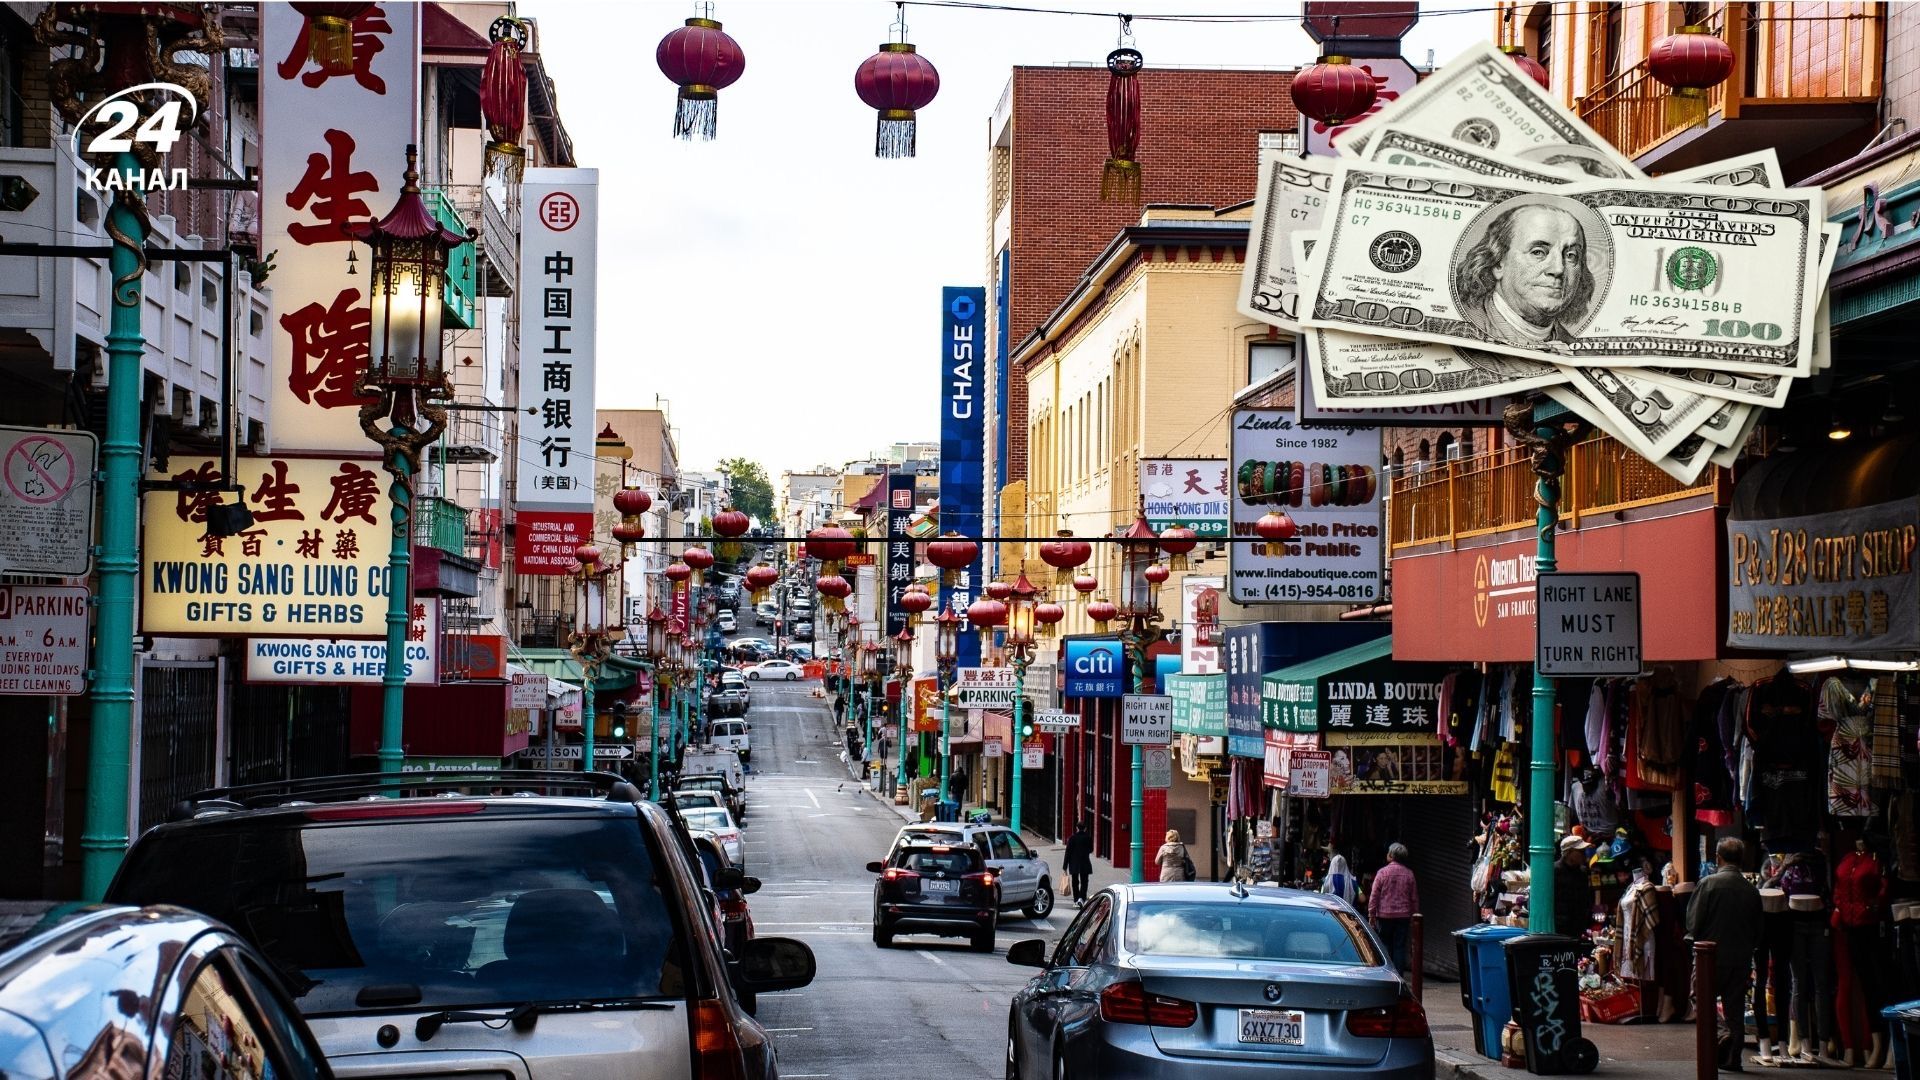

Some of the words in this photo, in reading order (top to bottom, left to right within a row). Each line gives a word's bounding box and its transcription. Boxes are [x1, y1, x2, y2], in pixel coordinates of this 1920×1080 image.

[541, 250, 574, 469] 中国工商银行
[952, 324, 973, 420] CHASE
[1237, 414, 1293, 431] Linda
[1275, 438, 1308, 449] Since
[1311, 438, 1338, 449] 1982
[1146, 463, 1174, 476] 香港
[1147, 502, 1173, 515] HONG
[1175, 502, 1201, 515] KONG
[1203, 502, 1220, 515] DIM
[563, 522, 575, 532] AND
[1332, 521, 1379, 538] Price
[532, 544, 540, 553] OF
[1305, 542, 1362, 557] Public
[1782, 528, 1807, 586] 28
[1811, 535, 1857, 584] GIFT
[1862, 524, 1917, 578] SHOP
[523, 555, 549, 565] NATIONAL
[153, 561, 228, 594] KWONG
[238, 563, 294, 596] SANG
[303, 564, 358, 598] LUNG
[1235, 568, 1378, 580] www.lindaboutique.com
[1490, 558, 1518, 587] ORIENTAL
[1242, 587, 1260, 598] Tel:
[1265, 584, 1374, 600] (415)-954-0816
[1543, 586, 1586, 603] RIGHT
[1594, 586, 1633, 602] LANE
[15, 596, 84, 617] PARKING
[187, 602, 252, 622] GIFTS
[263, 602, 277, 623] &
[287, 603, 364, 624] HERBS
[1497, 602, 1509, 619] SAN
[1561, 614, 1616, 634] MUST
[1791, 595, 1846, 637] SALE
[25, 630, 33, 638] TO
[42, 627, 55, 648] 6
[58, 637, 80, 648] A.M.
[5, 651, 54, 663] EVERYDAY
[256, 643, 312, 658] KWONG
[316, 644, 357, 659] SANG
[406, 646, 430, 661] CO.
[1543, 646, 1583, 662] TURN
[1591, 646, 1636, 662] RIGHT
[34, 664, 79, 676] HOLIDAYS
[273, 660, 327, 675] GIFTS
[333, 661, 346, 676] &
[352, 662, 413, 677] HERS
[1075, 652, 1113, 674] citi
[23, 679, 71, 691] CLEANING
[513, 675, 523, 685] NO
[1074, 682, 1115, 692] 花旗銀行
[968, 690, 1016, 703] PARKING
[1328, 682, 1378, 700] LINDA
[1125, 702, 1147, 711] RIGHT
[1149, 702, 1170, 711] LANE
[1034, 715, 1078, 724] JACKSON
[1129, 715, 1166, 725] MUST
[1328, 703, 1430, 728] 麗達珠
[1125, 729, 1145, 738] TURN
[1147, 729, 1170, 738] RIGHT
[521, 747, 579, 758] JACSON
[1291, 758, 1302, 769] NO
[1304, 760, 1329, 770] STOPPING
[1301, 780, 1318, 788] TIME
[1243, 1020, 1300, 1039] 6XXZ730
